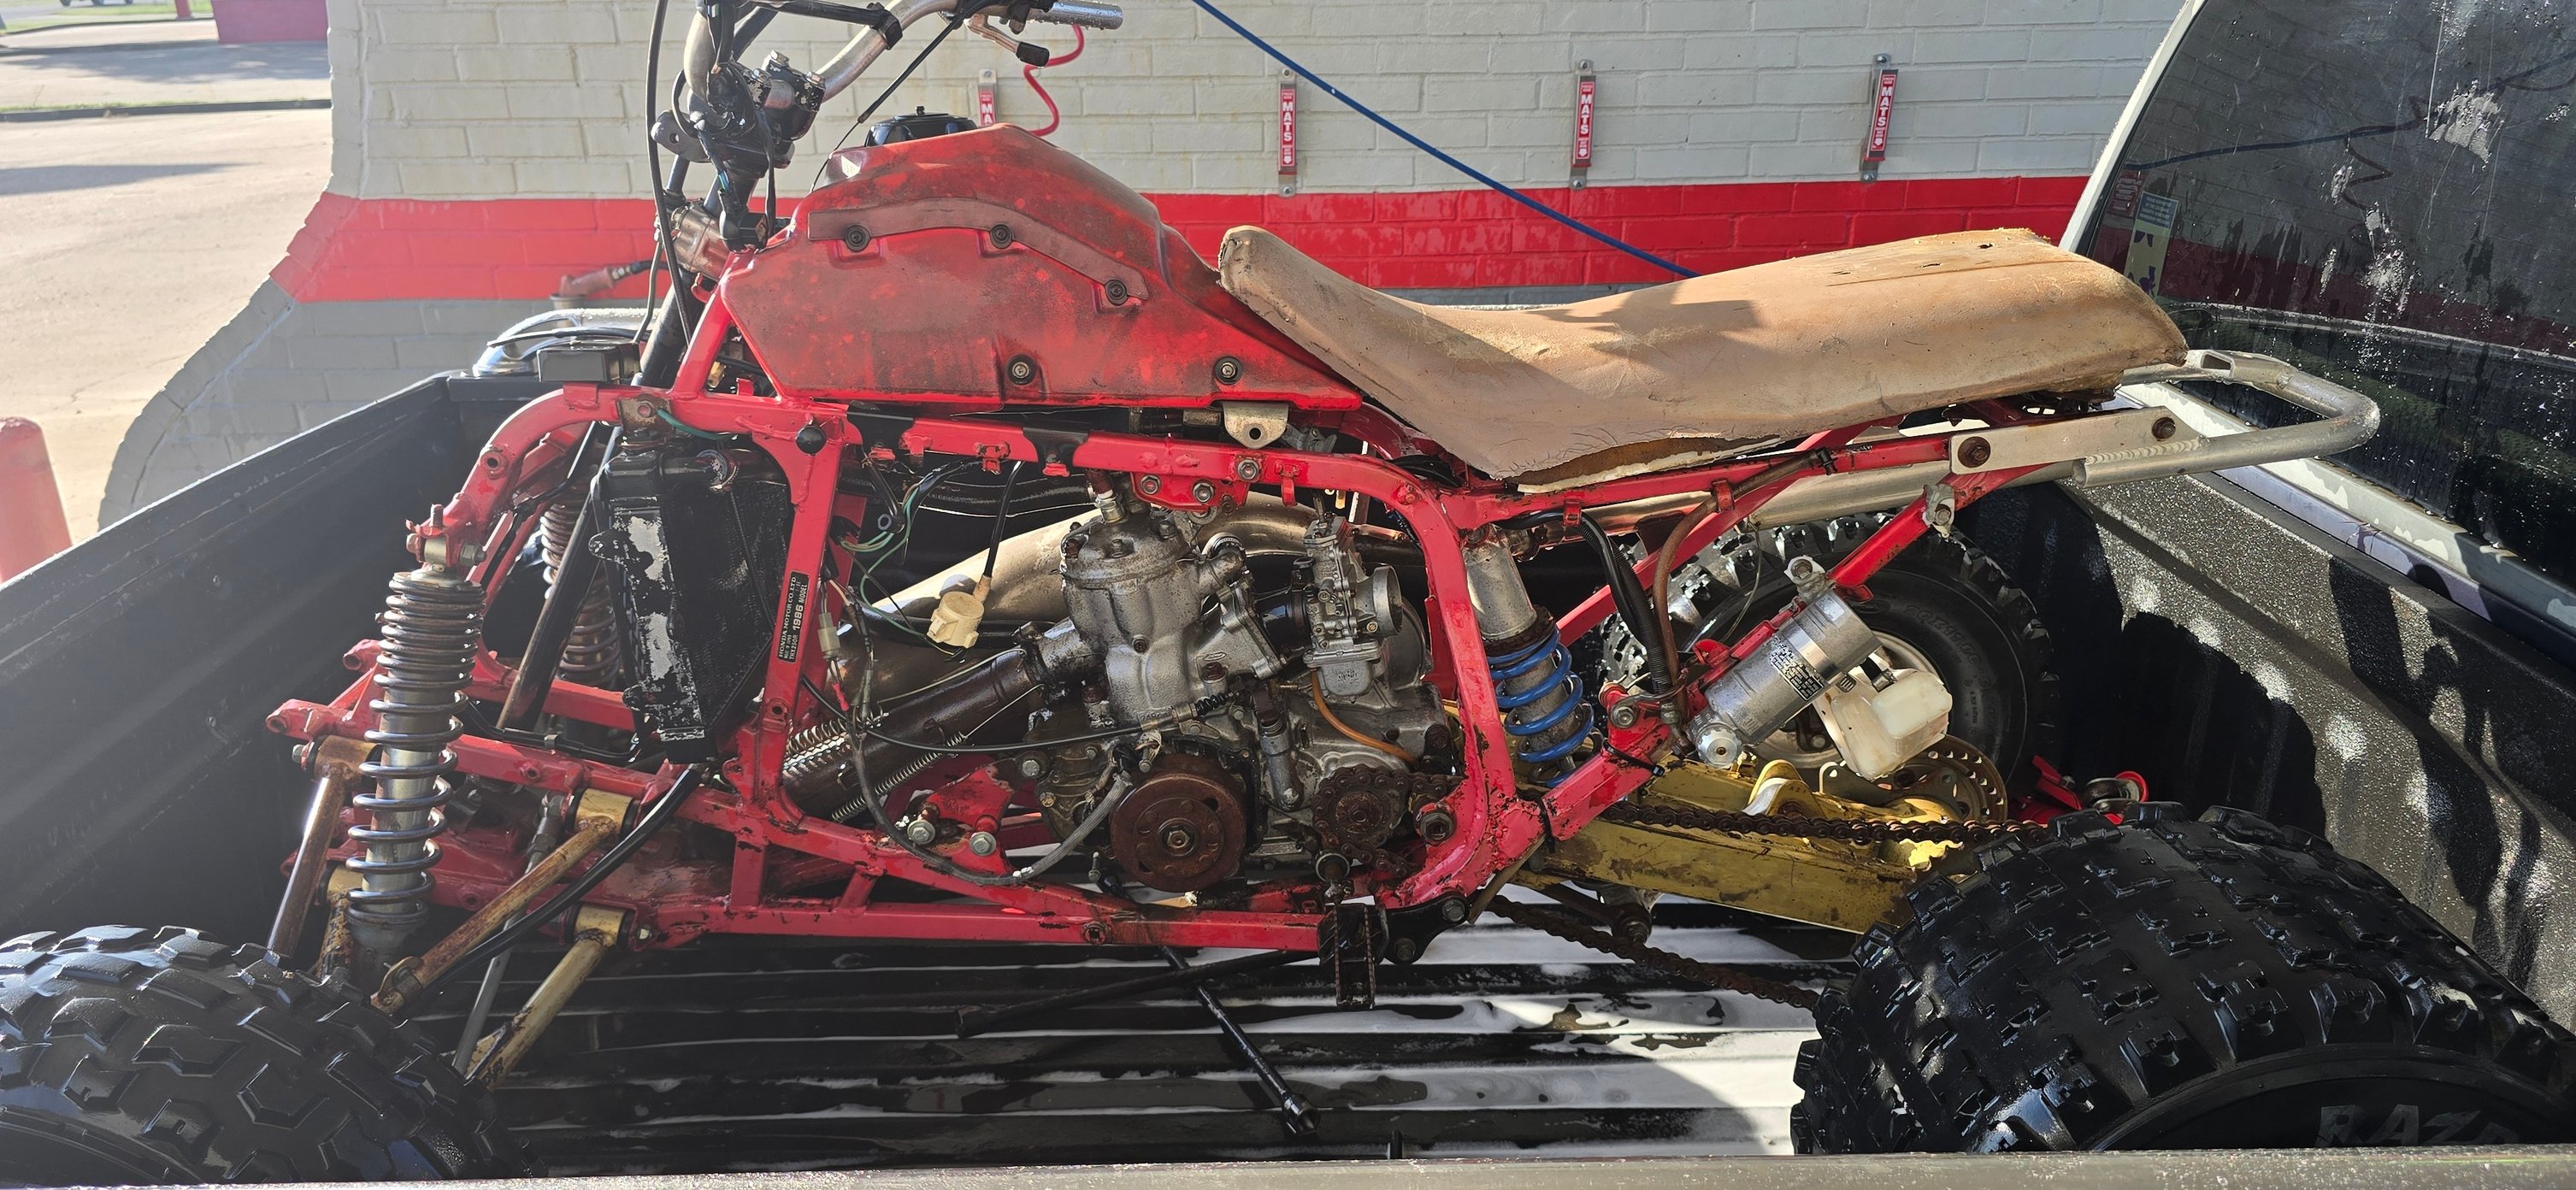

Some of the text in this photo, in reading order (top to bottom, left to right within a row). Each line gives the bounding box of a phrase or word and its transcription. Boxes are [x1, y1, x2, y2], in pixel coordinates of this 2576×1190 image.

[1282, 102, 1294, 142] MATS
[1580, 94, 1592, 135] MATS
[1877, 85, 1893, 127] MATS
[793, 604, 804, 631] 1986
[799, 584, 808, 604] MODEL
[778, 630, 788, 657] HONDA
[783, 604, 792, 629] MOTOR
